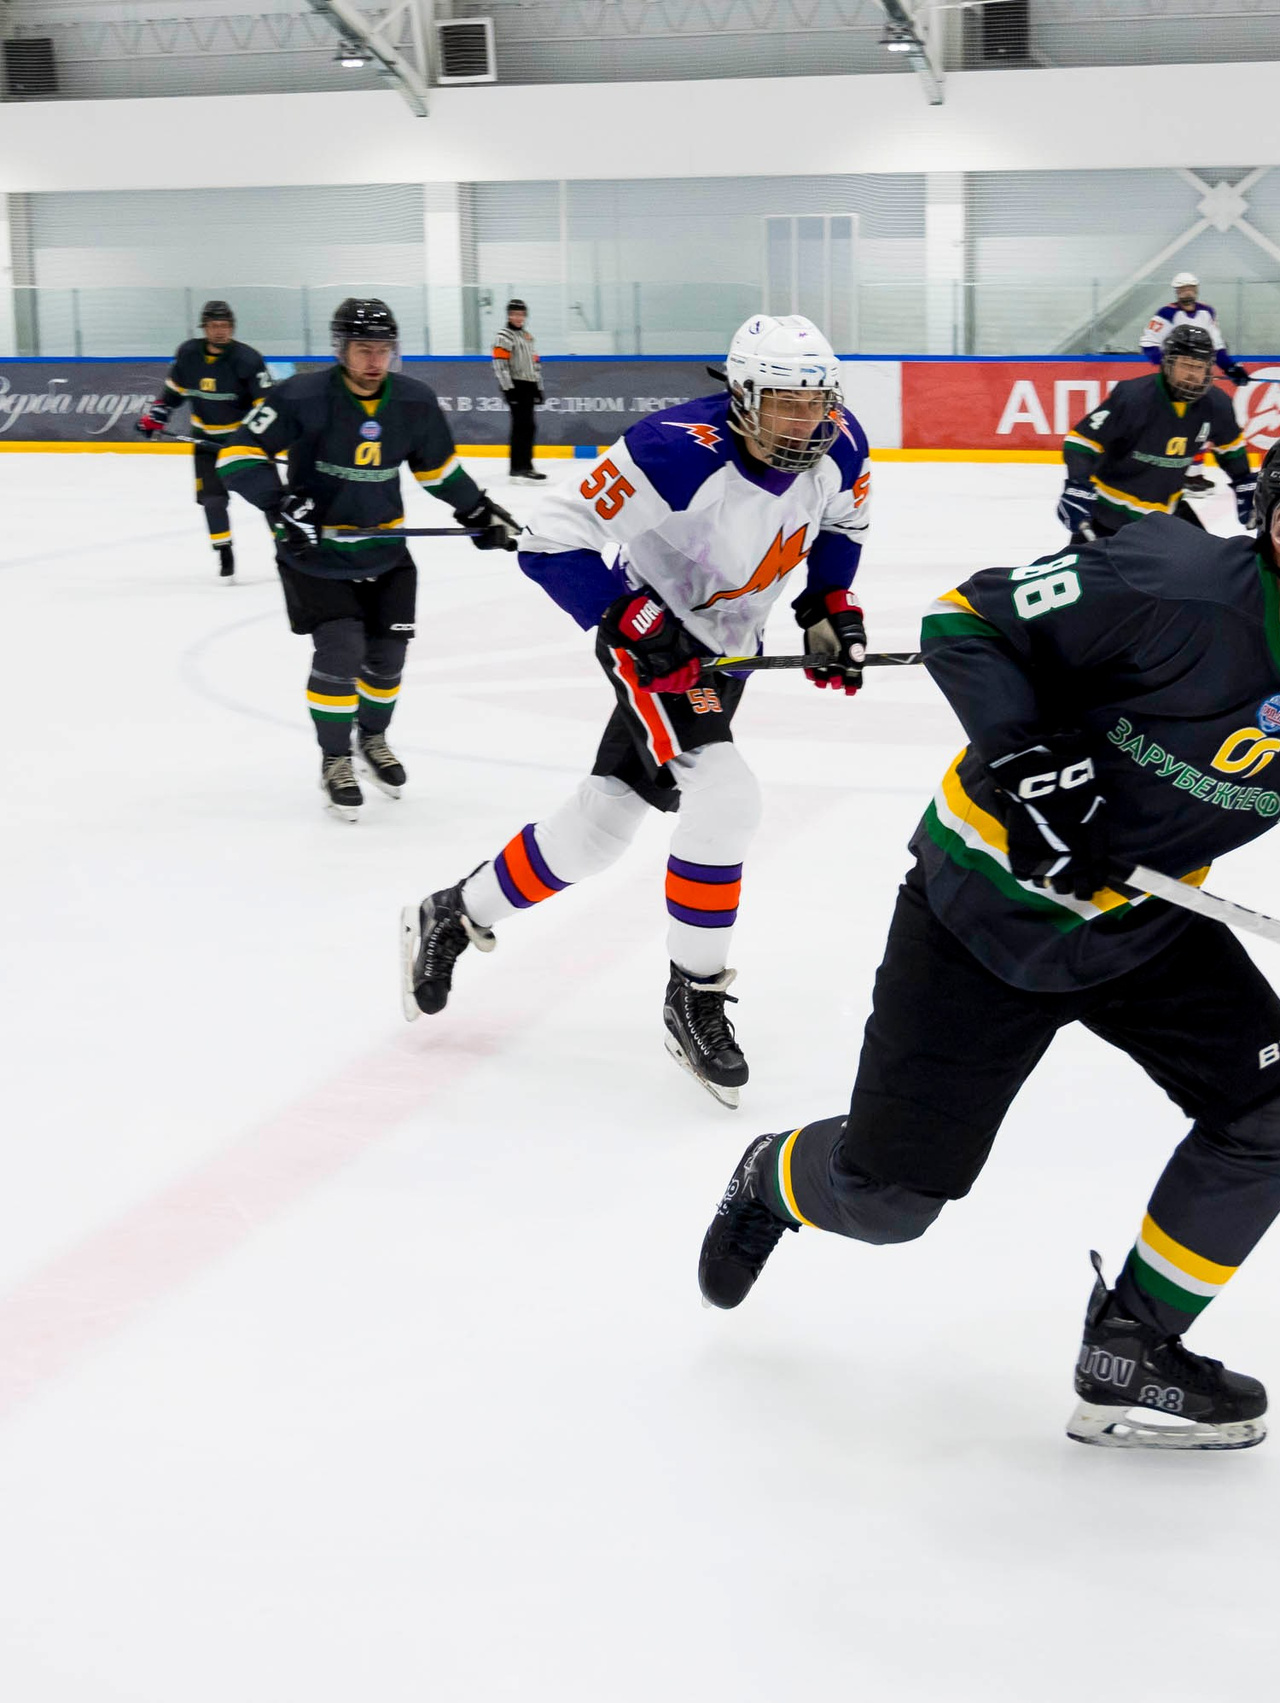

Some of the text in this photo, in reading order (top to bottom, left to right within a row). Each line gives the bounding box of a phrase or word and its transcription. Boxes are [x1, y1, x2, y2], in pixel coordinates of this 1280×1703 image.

[579, 457, 637, 520] 55
[1008, 553, 1083, 621] 88
[685, 687, 723, 714] 55
[1139, 1384, 1185, 1412] 88
